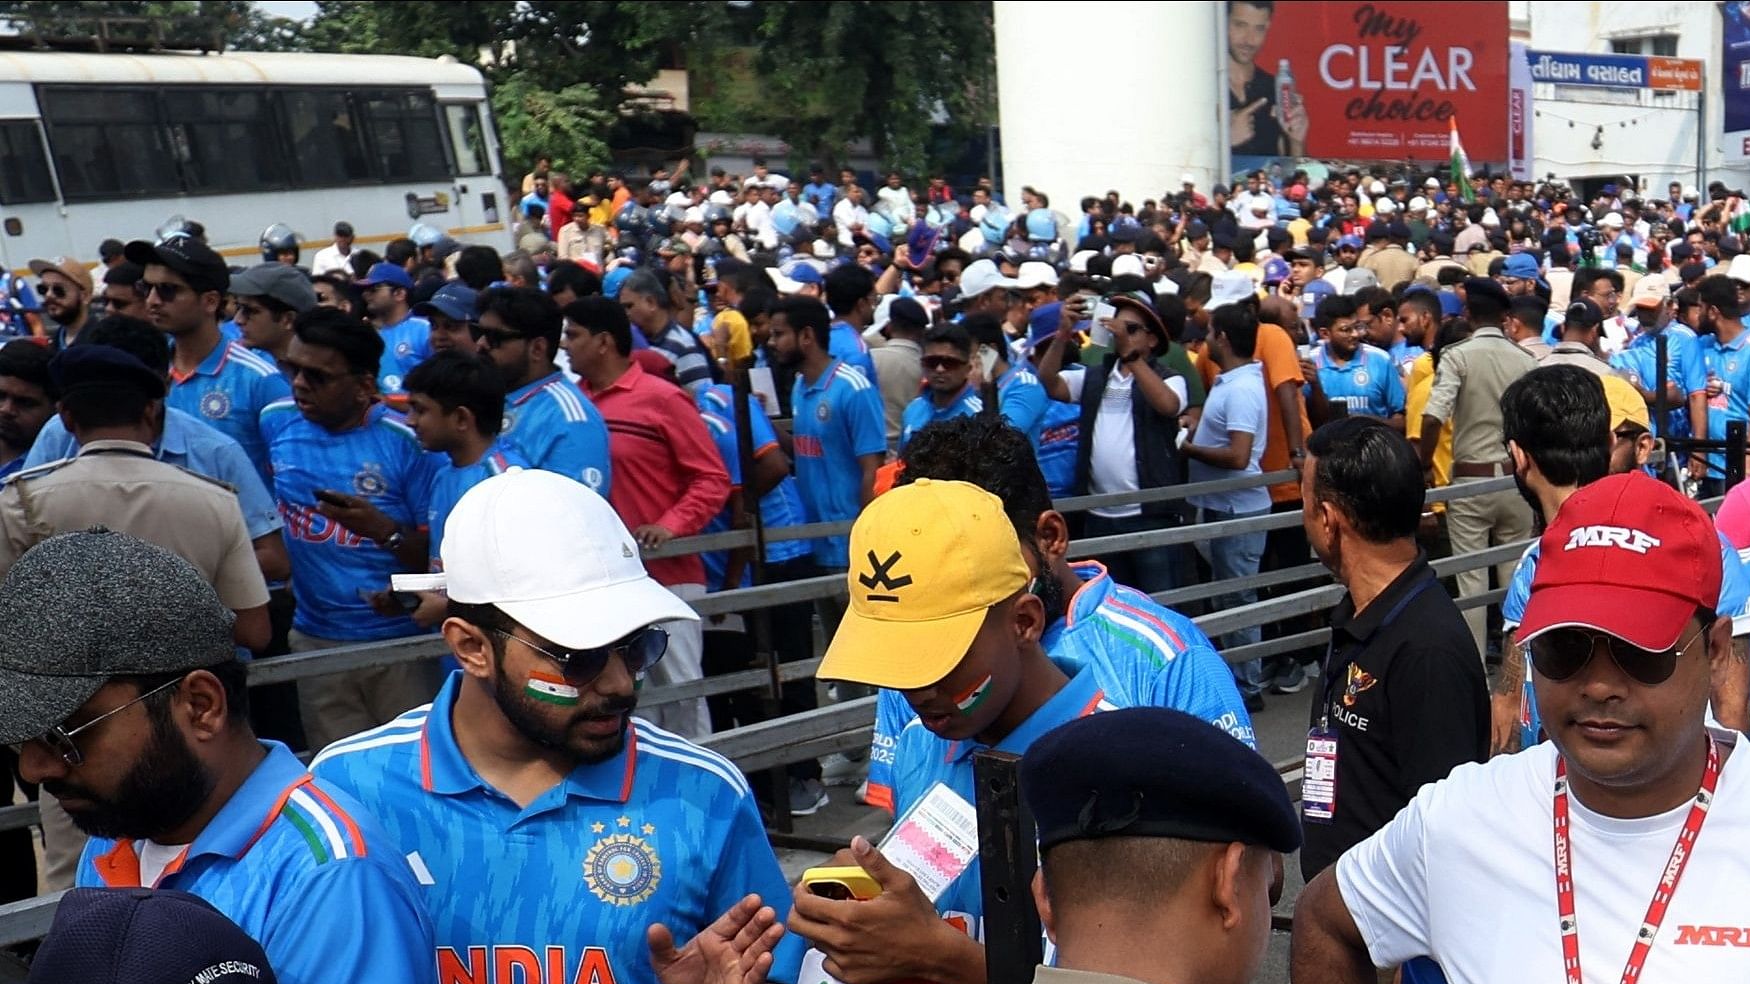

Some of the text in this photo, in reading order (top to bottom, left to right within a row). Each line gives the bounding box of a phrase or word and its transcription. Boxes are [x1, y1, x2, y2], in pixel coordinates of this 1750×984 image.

[1354, 4, 1421, 58] My
[1319, 44, 1477, 91] CLEAR
[1345, 83, 1457, 121] choice
[1564, 525, 1661, 554] MRF
[1557, 833, 1568, 876] MRF
[1662, 843, 1685, 888] MRF
